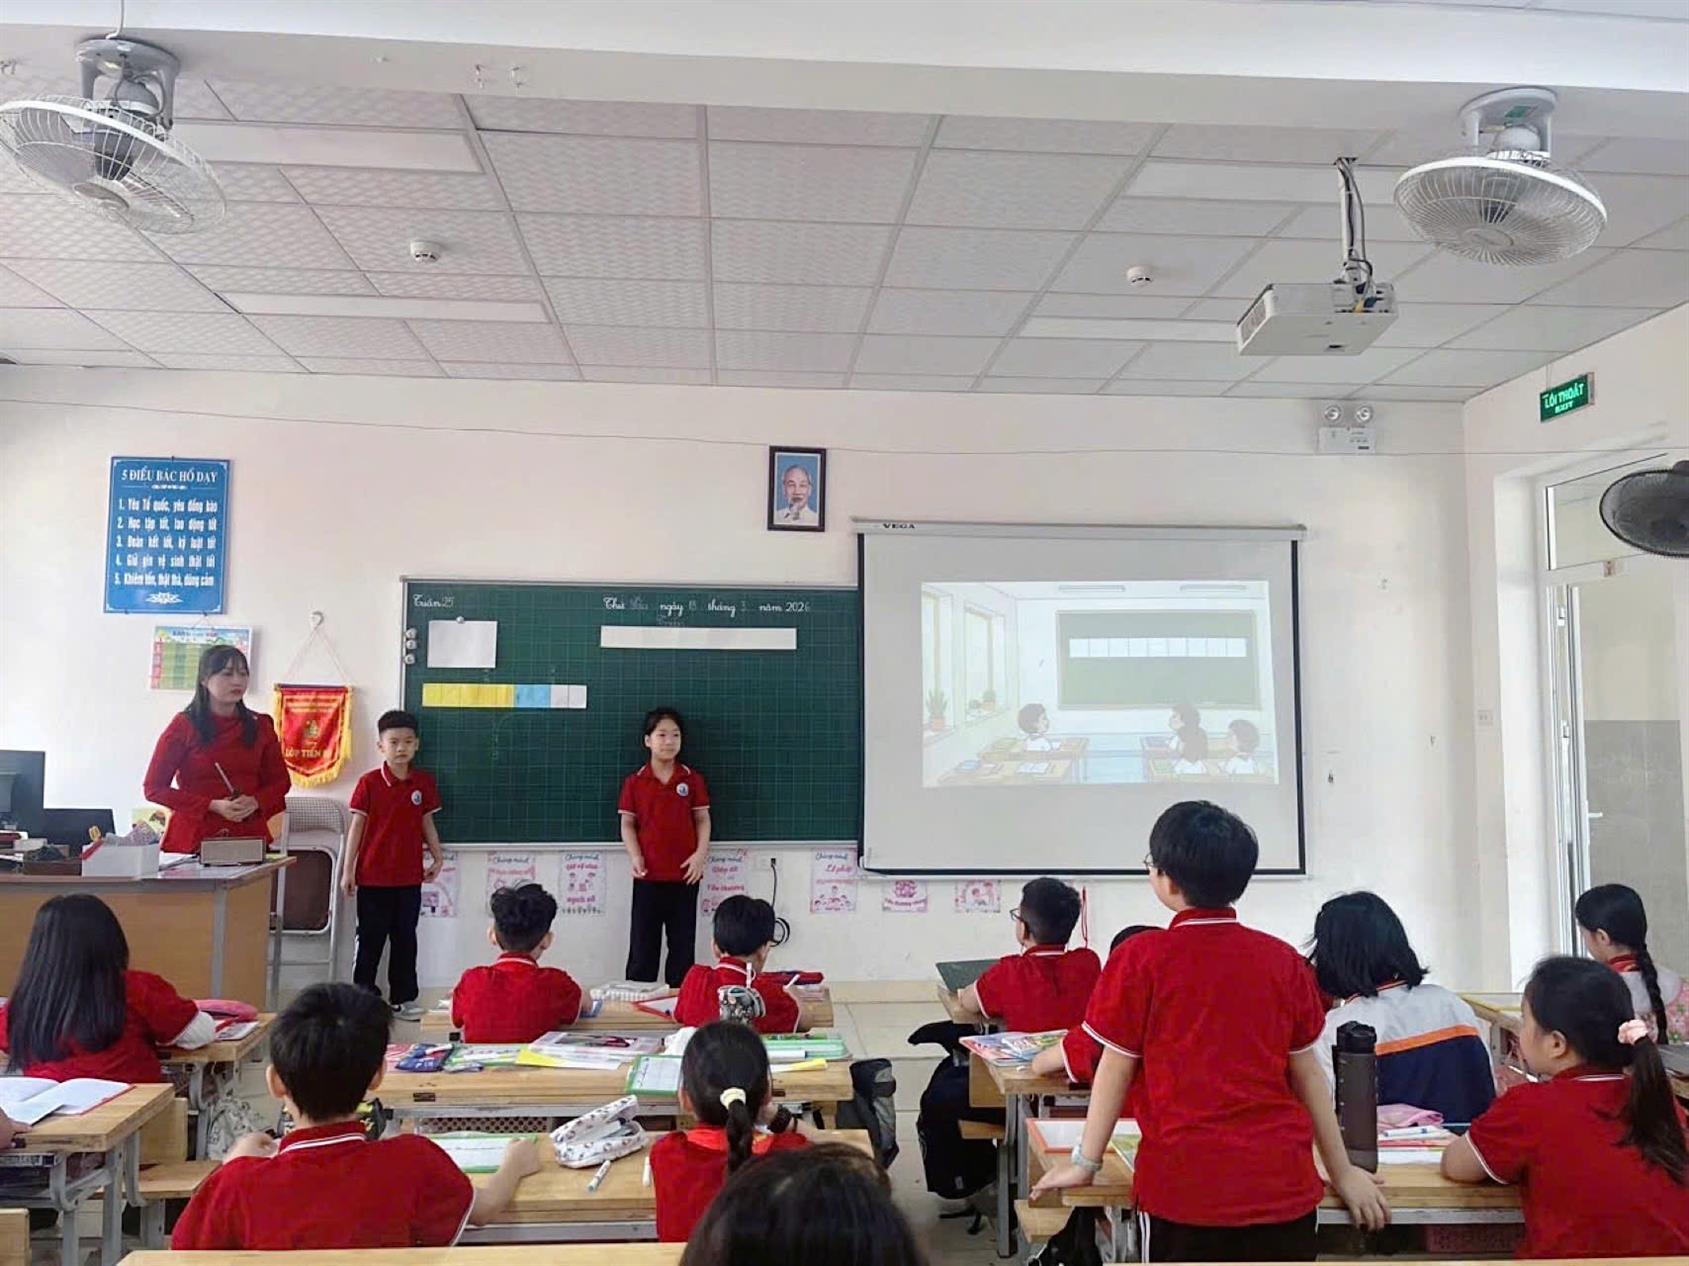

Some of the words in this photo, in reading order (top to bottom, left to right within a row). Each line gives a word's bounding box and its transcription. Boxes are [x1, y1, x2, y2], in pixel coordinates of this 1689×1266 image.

[121, 469, 128, 481] 5
[156, 468, 178, 482] BÁC
[179, 467, 195, 482] HỒ
[196, 471, 218, 485] DẠY
[660, 601, 684, 617] ngày
[707, 598, 737, 618] tháng
[759, 603, 784, 612] năm
